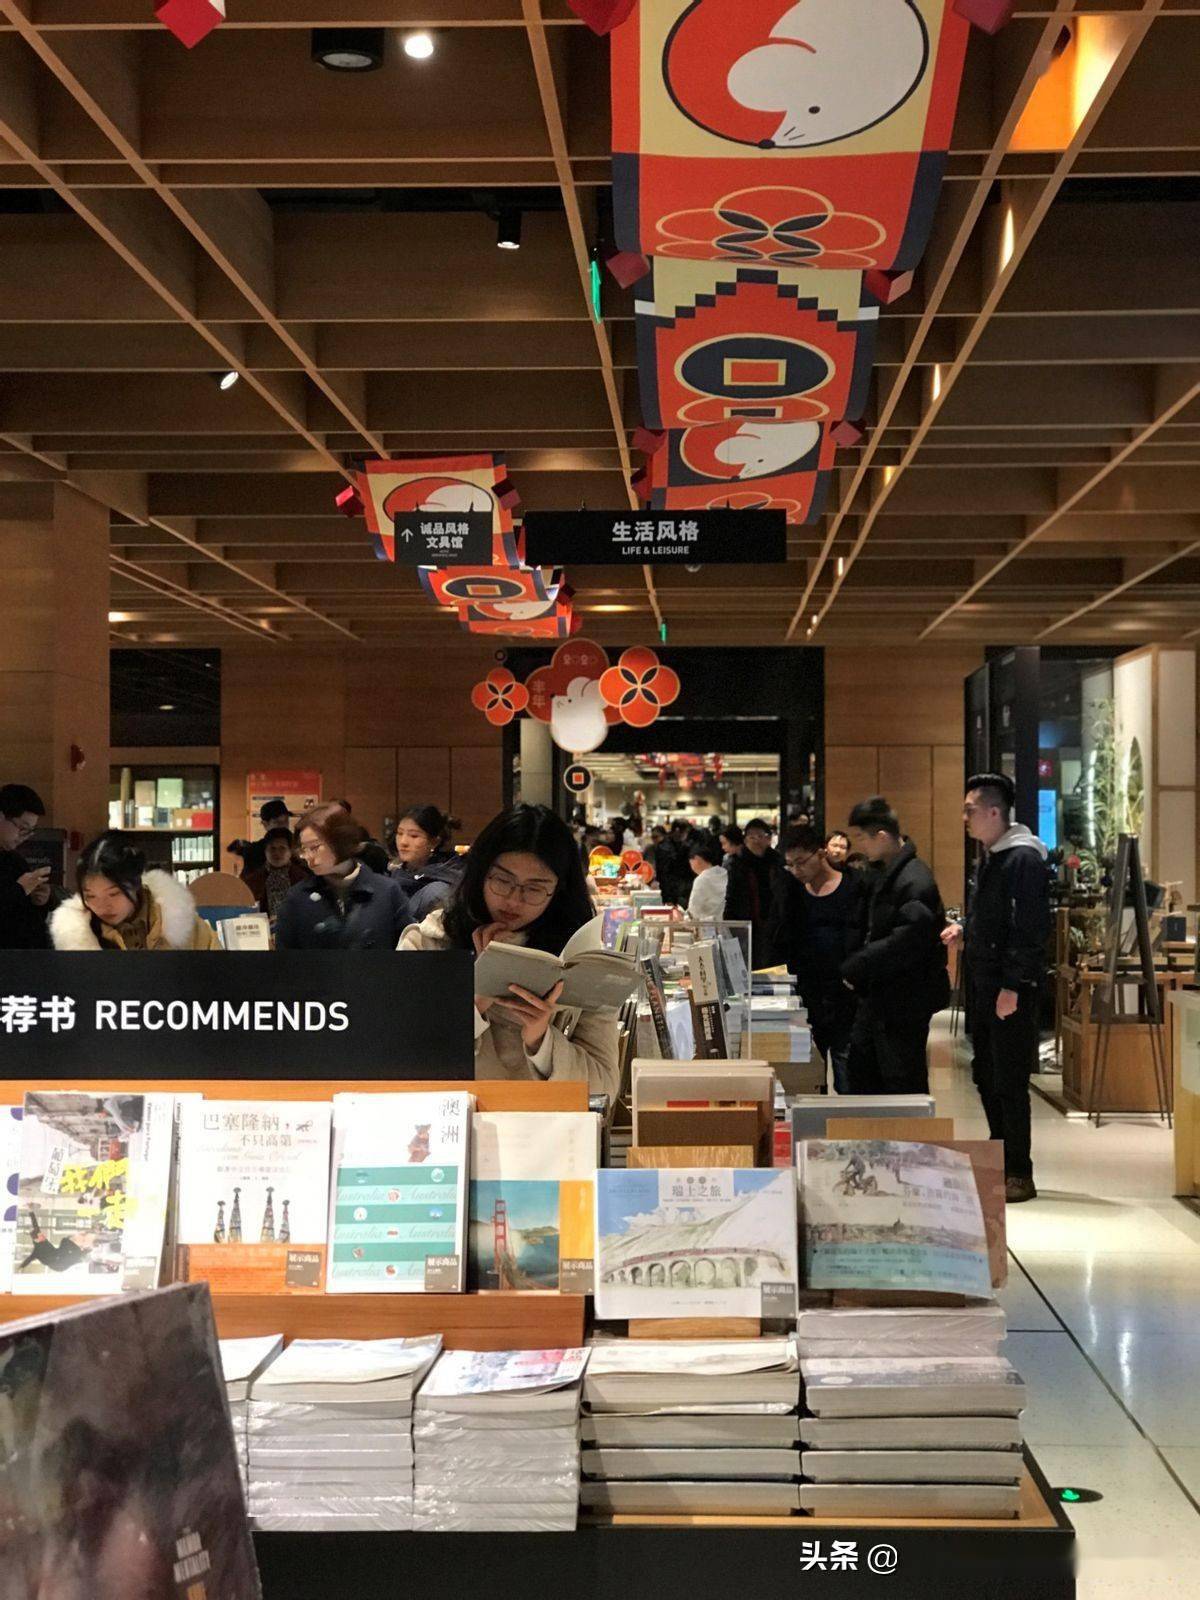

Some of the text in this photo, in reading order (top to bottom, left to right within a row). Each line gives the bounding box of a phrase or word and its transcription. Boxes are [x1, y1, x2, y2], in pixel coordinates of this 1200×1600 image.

[420, 522, 469, 535] 诚品风格
[612, 520, 699, 542] 生活风格
[426, 536, 464, 549] 文具馆
[621, 546, 690, 555] LIFE & LEISURE
[0, 995, 350, 1033] 荐书 RECOMMENDS
[440, 1098, 460, 1144] 澳洲
[240, 1134, 292, 1147] 不只高第
[672, 1184, 721, 1197] 瑞士之旅
